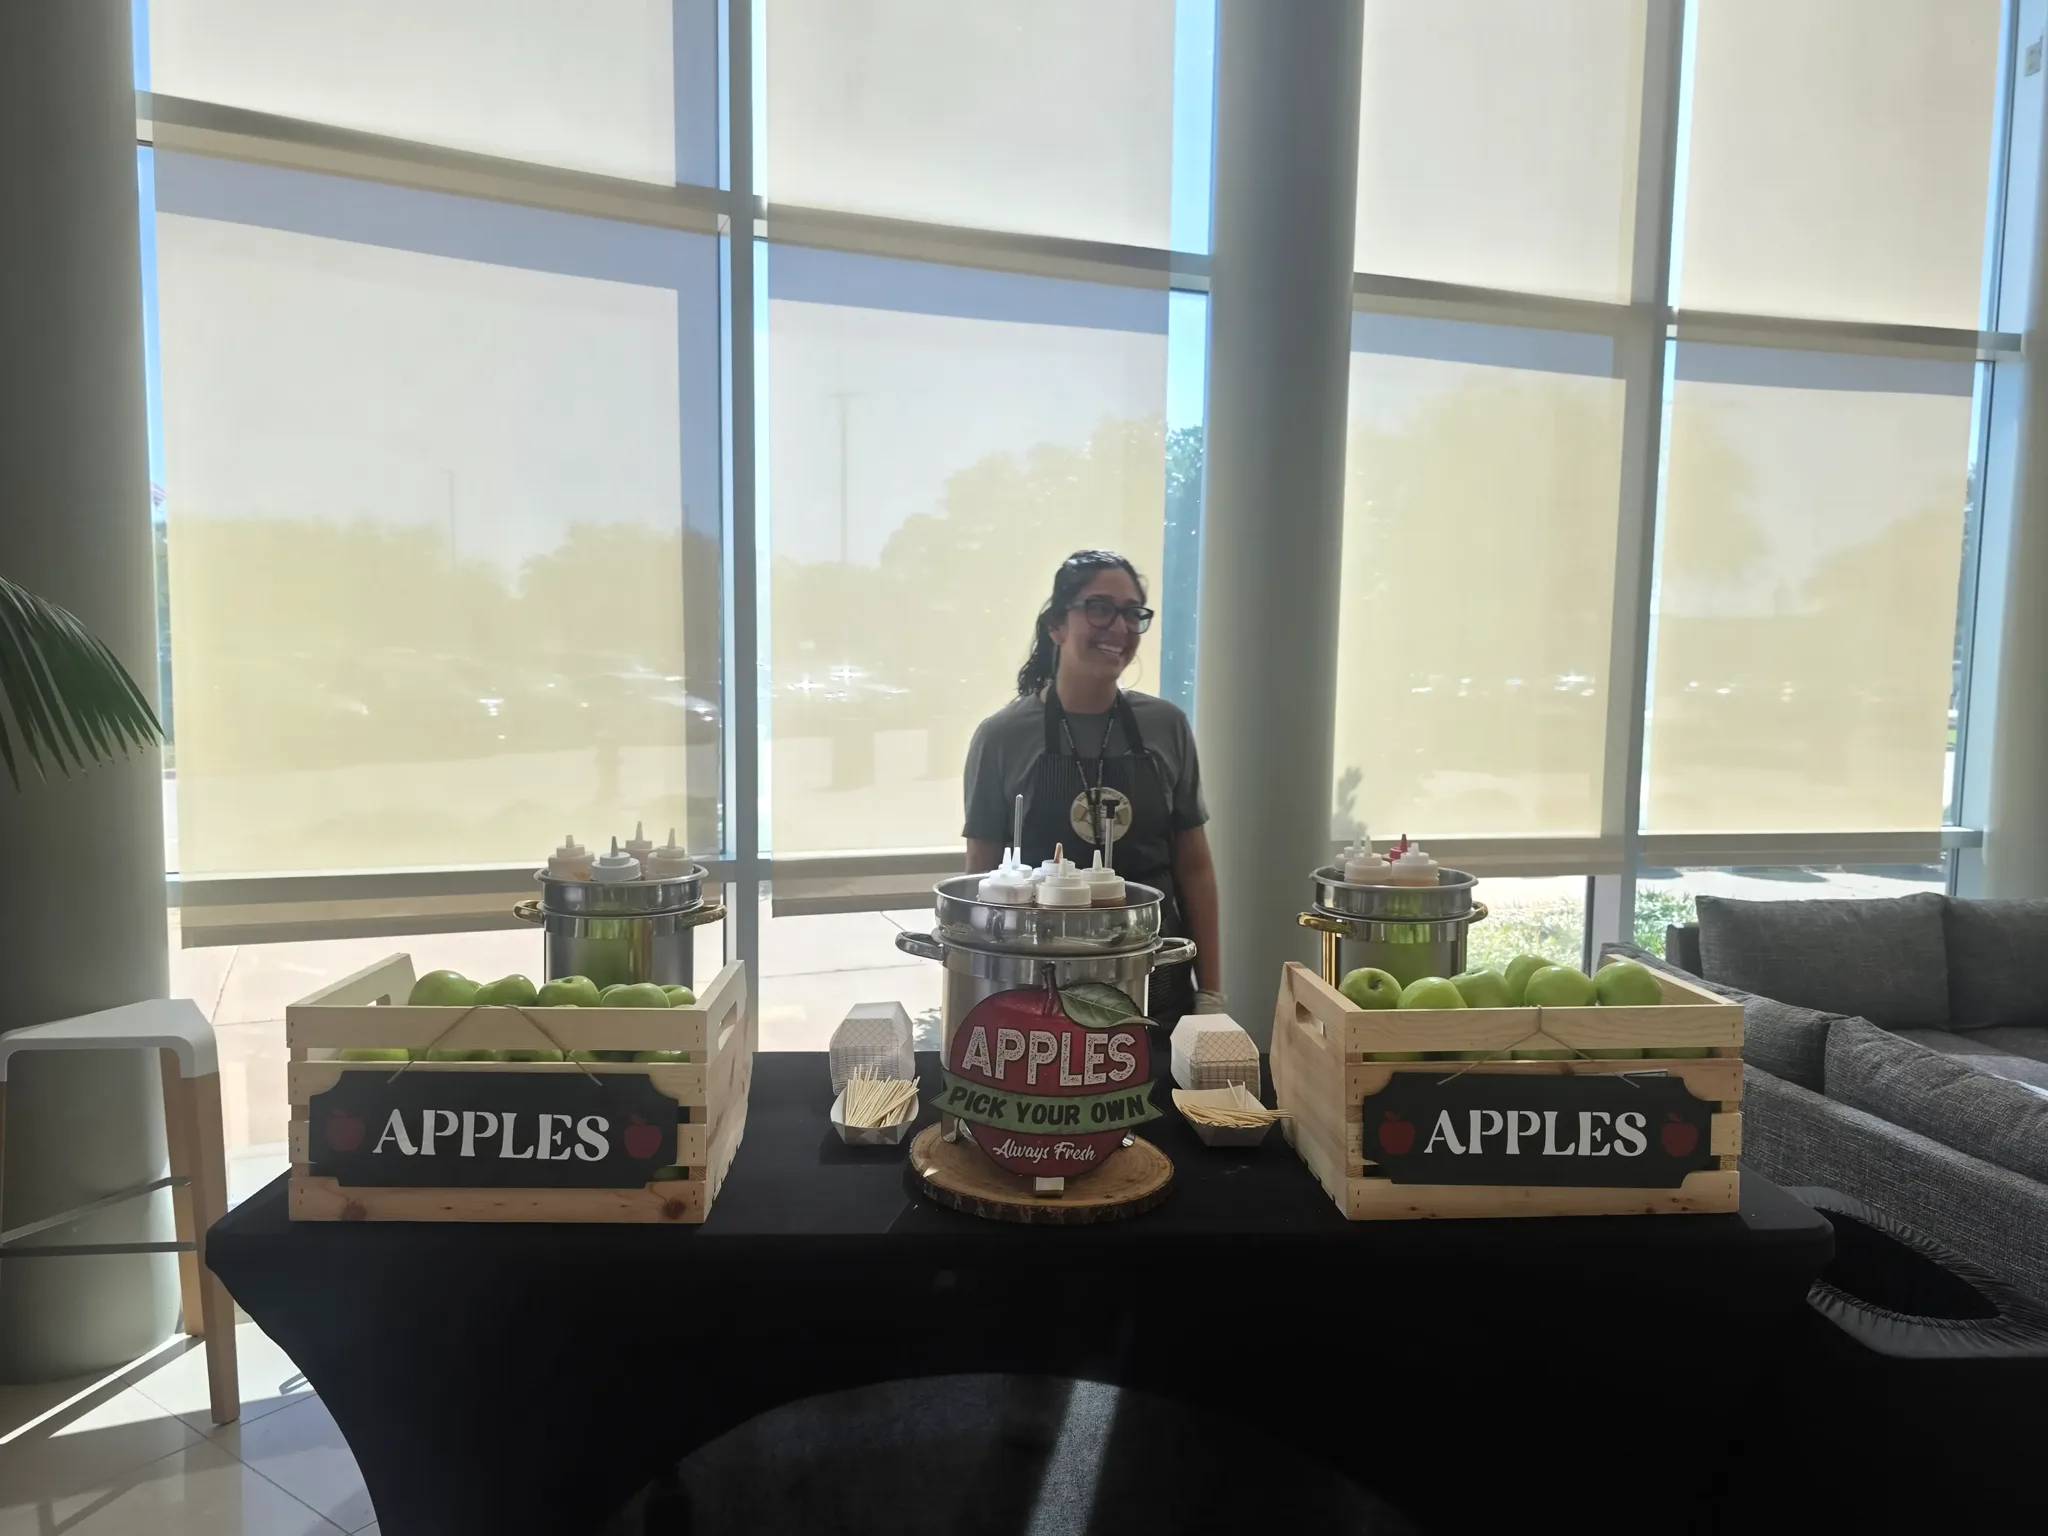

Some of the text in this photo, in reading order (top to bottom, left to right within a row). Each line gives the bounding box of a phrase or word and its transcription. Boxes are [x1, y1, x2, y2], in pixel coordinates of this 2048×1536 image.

[961, 1026, 1136, 1086] APPLES
[949, 1086, 1146, 1126] PICK YOUR OWN
[372, 1108, 610, 1162] APPLES
[992, 1138, 1096, 1164] Always Fresh
[1423, 1109, 1647, 1157] APPLES
